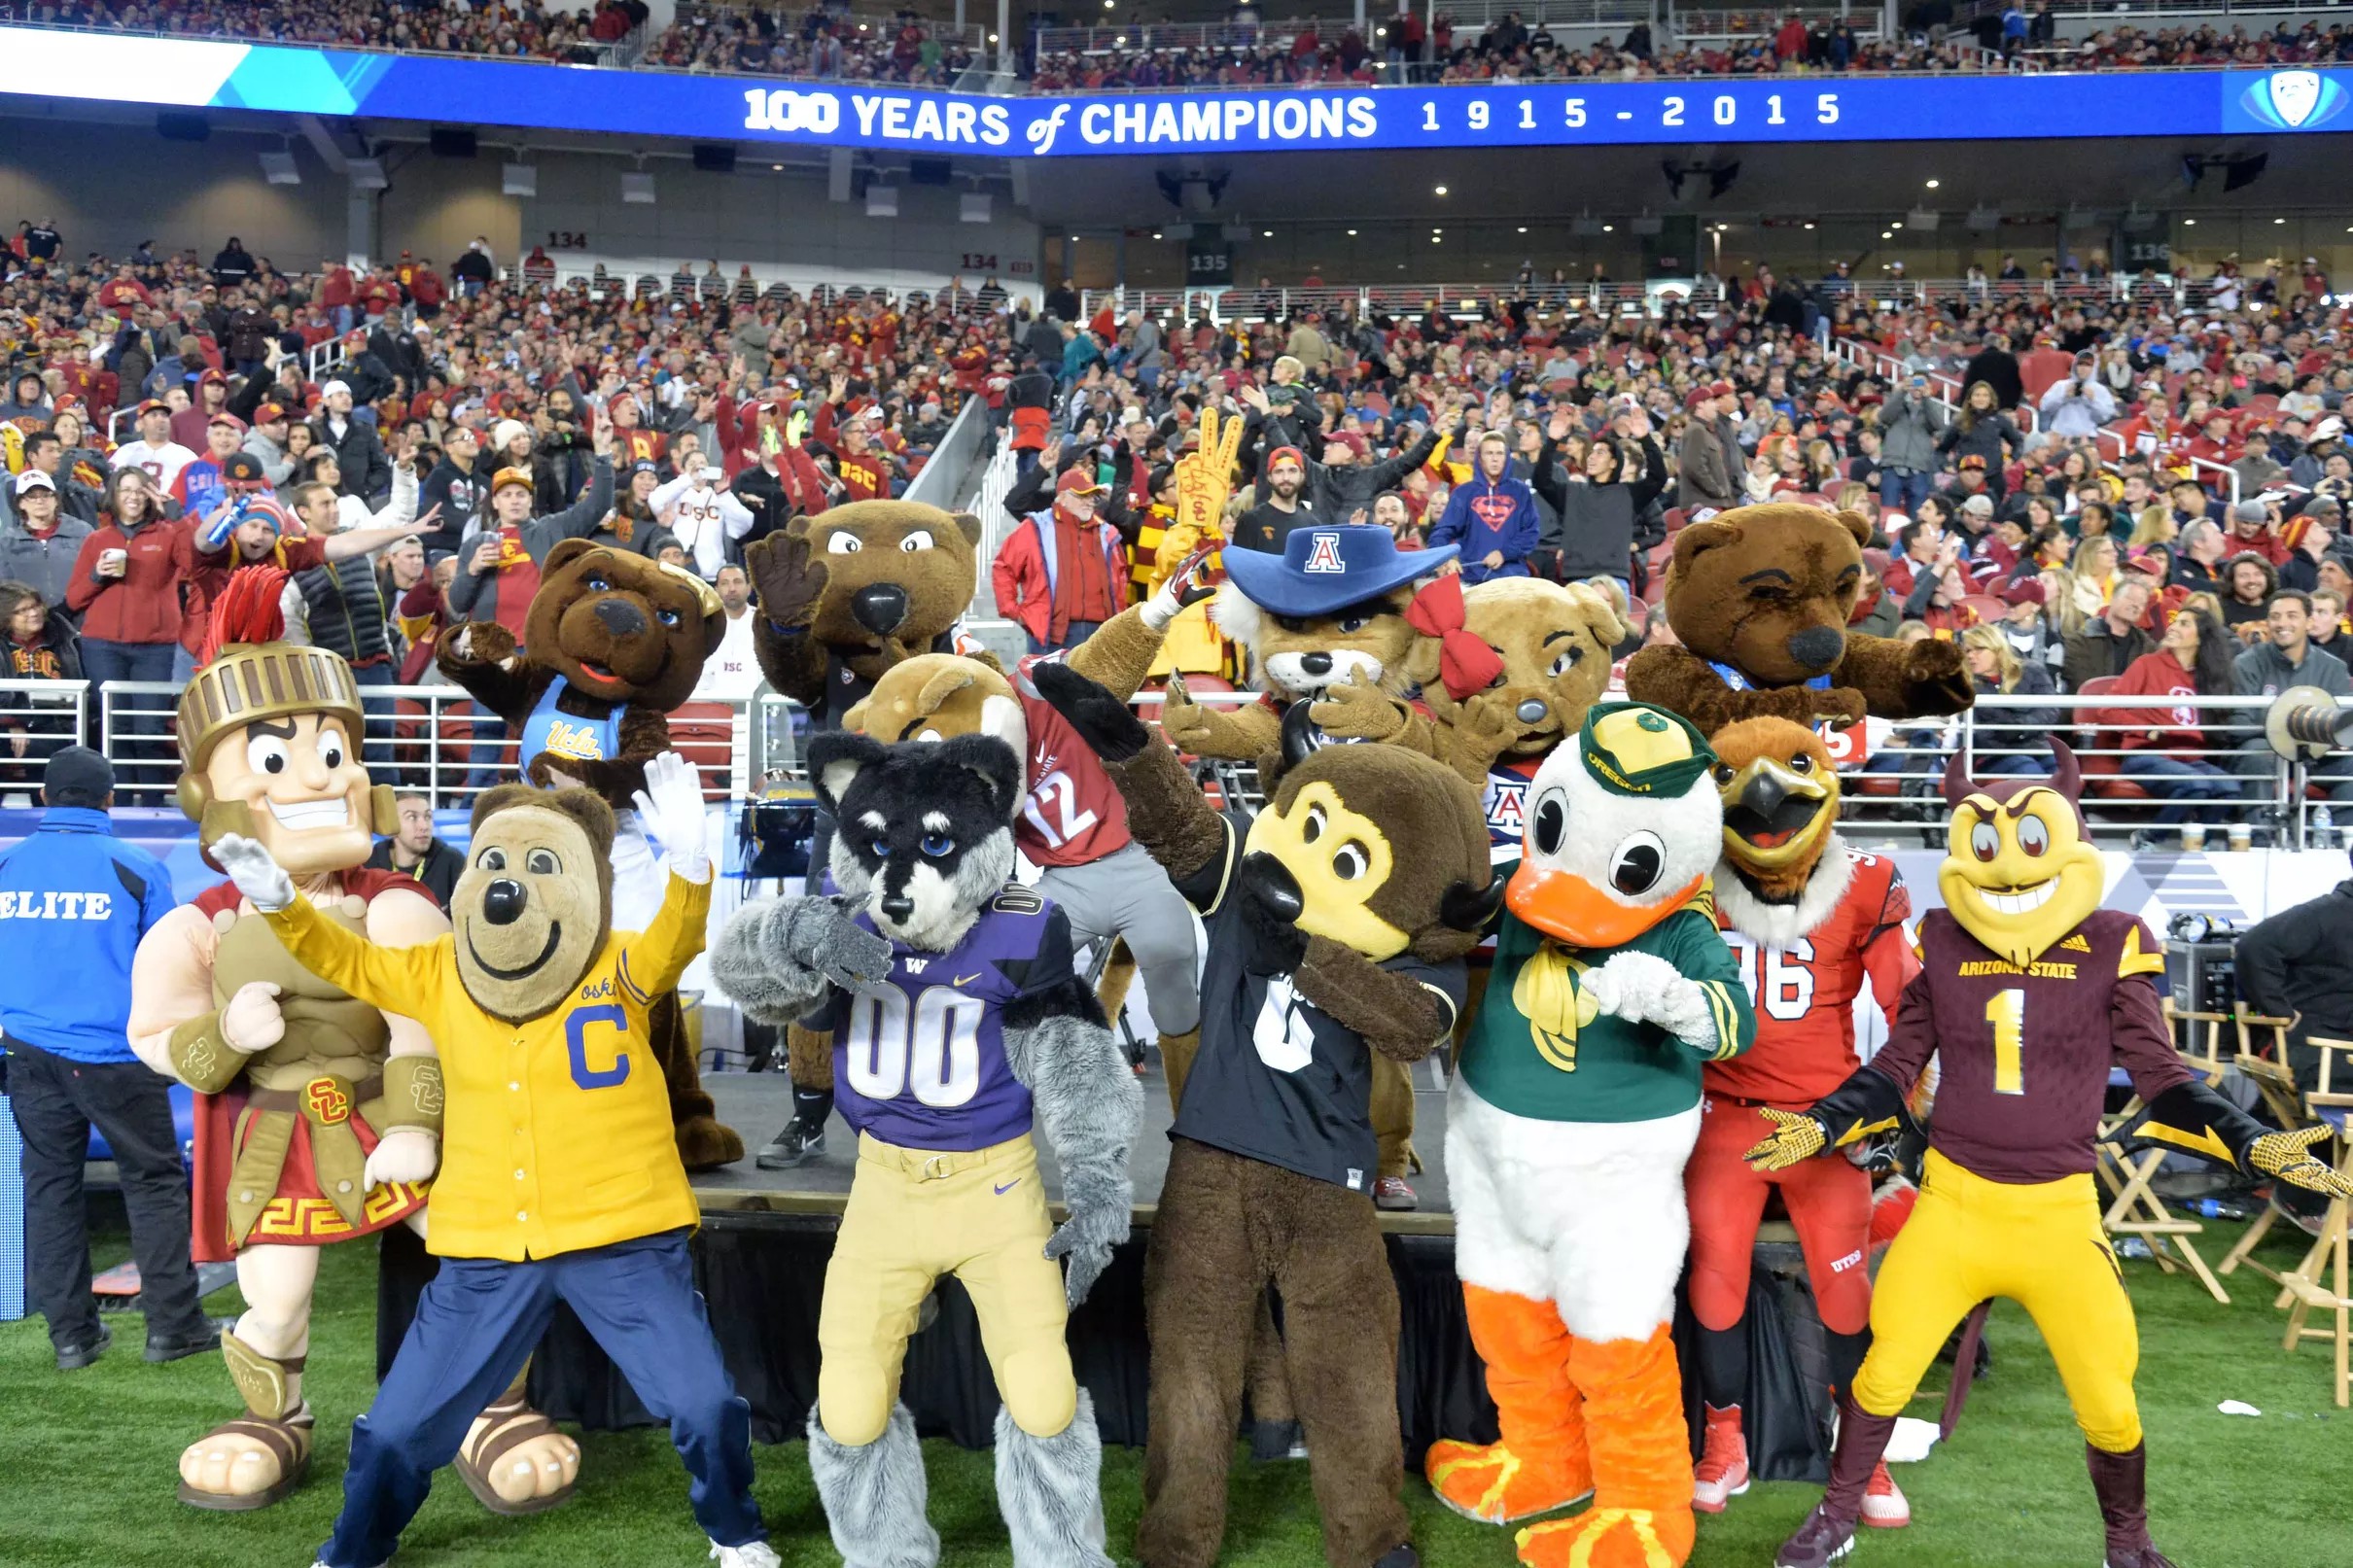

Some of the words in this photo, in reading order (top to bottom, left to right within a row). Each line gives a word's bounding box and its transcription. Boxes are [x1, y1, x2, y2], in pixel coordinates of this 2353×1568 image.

[744, 88, 839, 133] 100
[852, 95, 1009, 145] YEARS
[1026, 103, 1071, 155] of
[1080, 97, 1378, 144] CHAMPIONS
[546, 231, 587, 249] 134
[2130, 243, 2170, 261] 136
[962, 253, 997, 269] 134
[1190, 255, 1227, 271] 135
[839, 460, 877, 492] USC
[680, 502, 720, 521] USC
[1304, 533, 1346, 574] A
[1588, 752, 1651, 792] OREGON
[1024, 769, 1099, 850] 12
[1485, 783, 1528, 827] A
[0, 890, 113, 921] ELITE
[905, 958, 929, 975] W
[2028, 961, 2077, 979] STATE
[564, 1002, 631, 1091] C
[847, 979, 985, 1107] 00
[1984, 988, 2025, 1096] 1
[306, 1076, 348, 1124] SC
